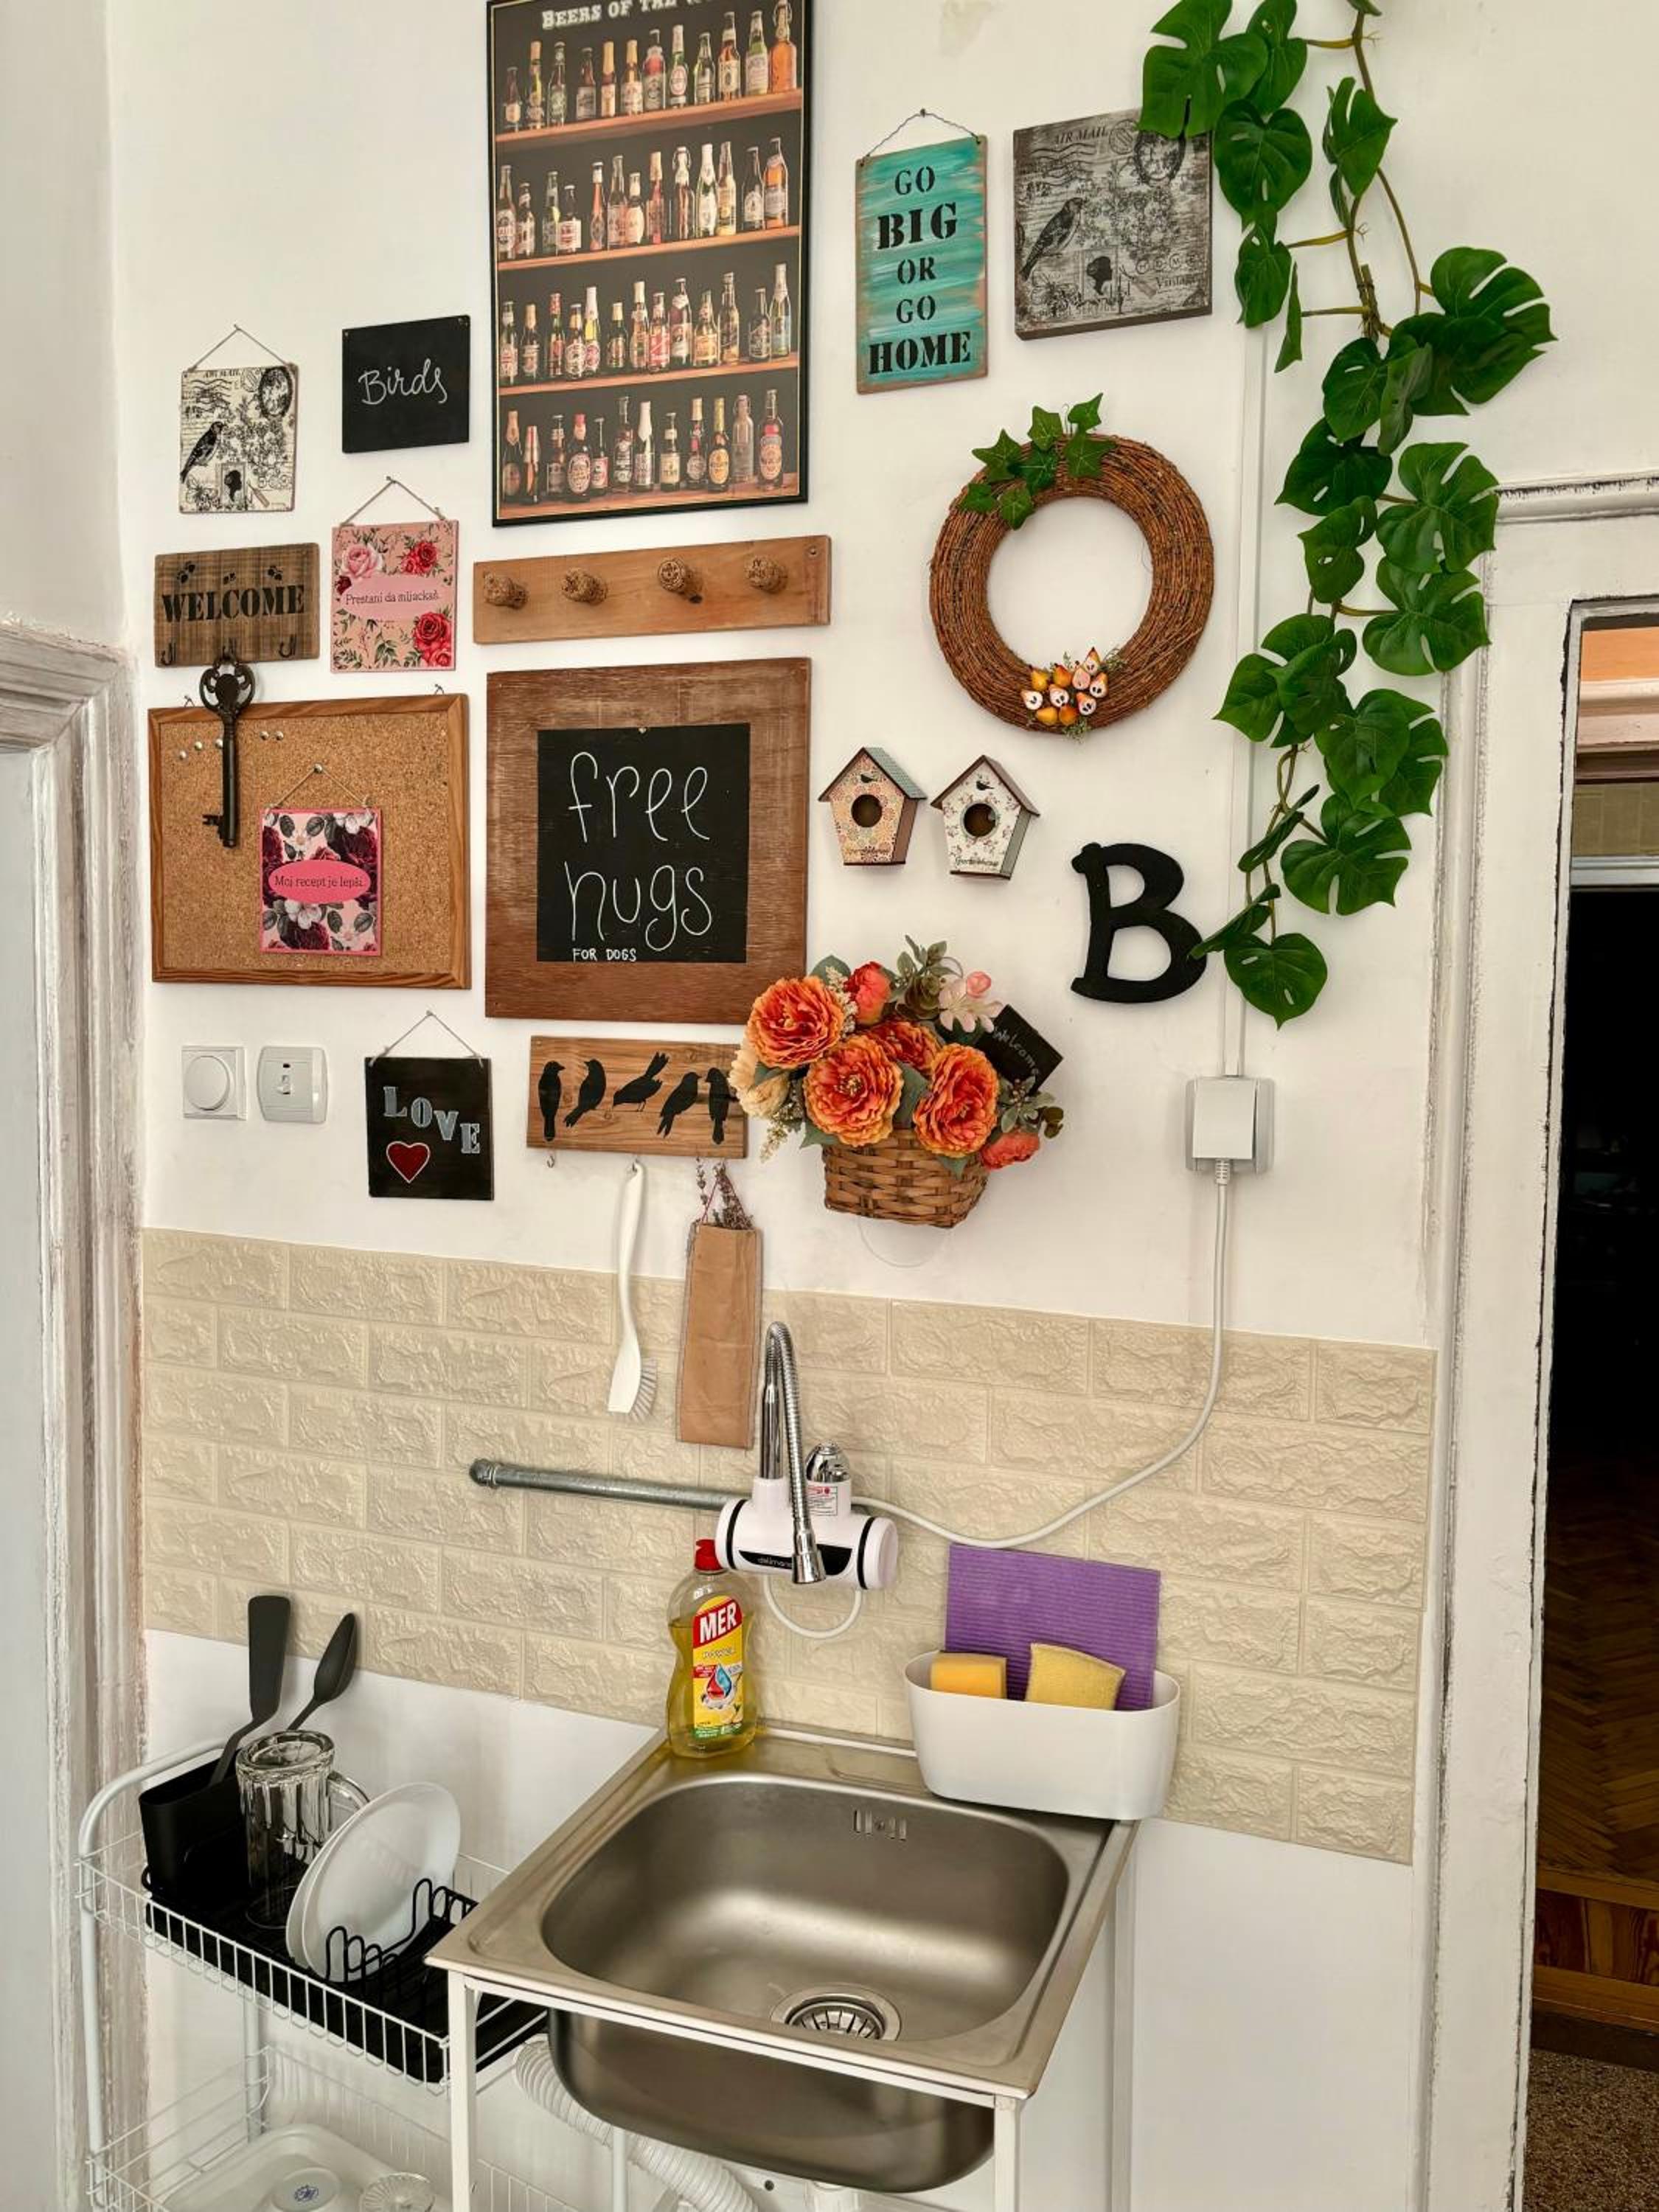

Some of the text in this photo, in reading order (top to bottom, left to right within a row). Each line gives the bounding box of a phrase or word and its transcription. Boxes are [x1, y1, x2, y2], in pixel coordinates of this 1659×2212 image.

[542, 4, 602, 29] BEERS
[608, 3, 632, 18] OF
[894, 166, 936, 195] GO
[877, 202, 957, 249] BIG
[897, 257, 936, 284] OR
[897, 296, 936, 323] GO
[868, 331, 971, 375] HOME
[358, 358, 448, 405] Birds
[162, 585, 305, 622] WELCOME
[568, 751, 710, 842] free
[1071, 842, 1207, 1004] B
[572, 948, 636, 961] FOR DOGS
[383, 1086, 480, 1153] LOVE
[700, 1601, 737, 1644] MER
